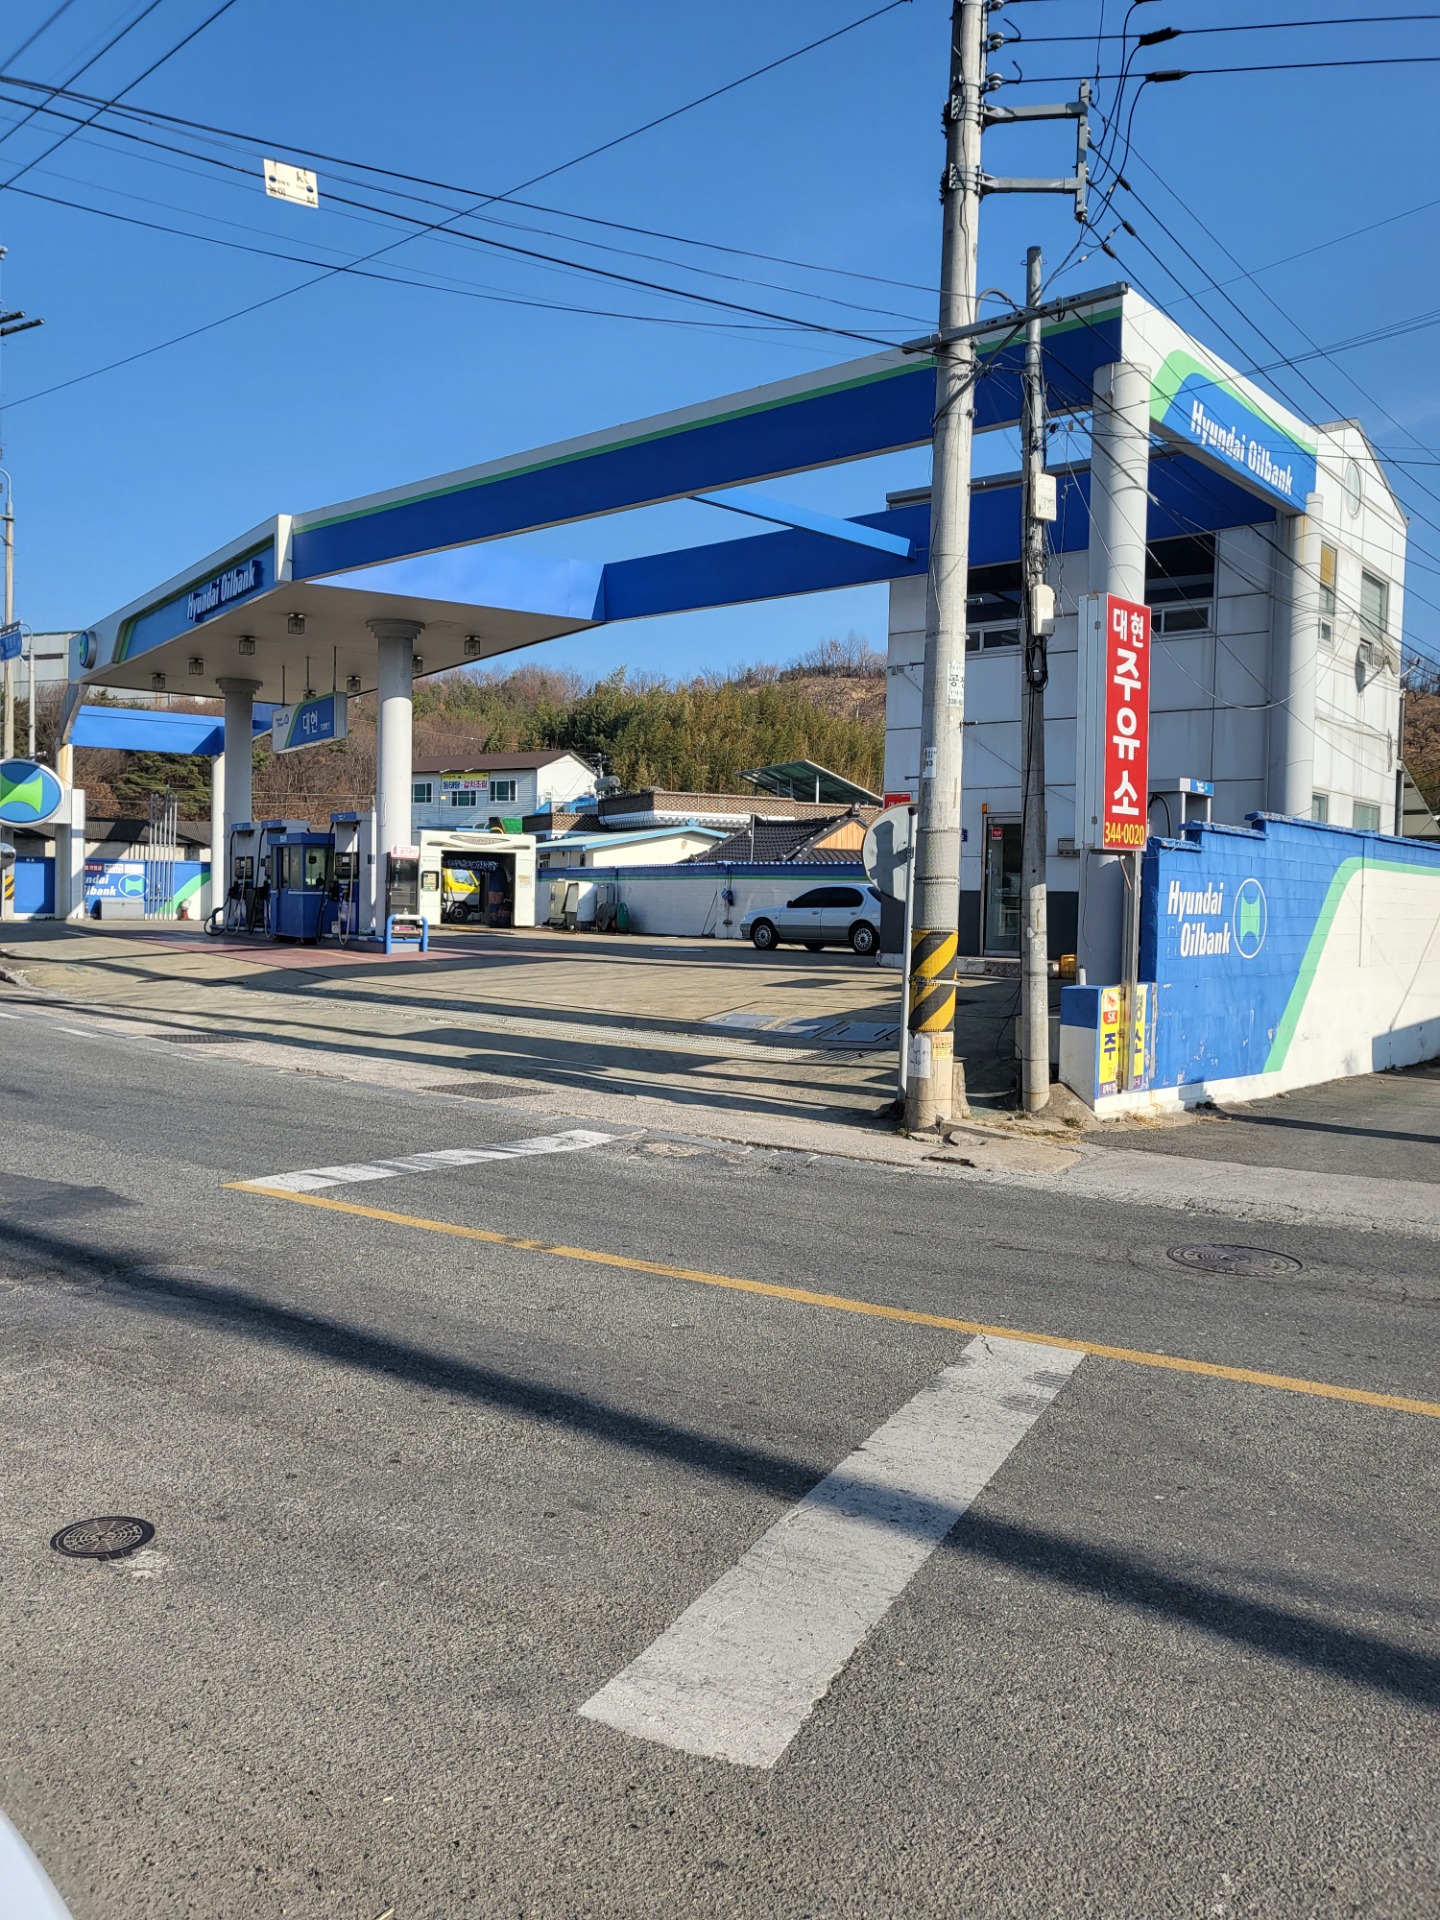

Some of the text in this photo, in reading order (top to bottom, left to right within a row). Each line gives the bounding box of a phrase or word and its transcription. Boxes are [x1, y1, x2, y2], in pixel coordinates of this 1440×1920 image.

[1191, 400, 1293, 496] Hyundai Oilbank
[187, 560, 256, 622] Hyundai Oilbank
[1113, 608, 1144, 648] 대현
[302, 710, 318, 735] 대현
[1112, 647, 1142, 817] 주유소
[464, 780, 487, 789] 갈치조림
[85, 874, 110, 885] ndai
[85, 885, 117, 896] ilbank
[1168, 880, 1224, 922] Hyundai
[1180, 922, 1231, 957] Oilbank
[1107, 1011, 1116, 1023] SK
